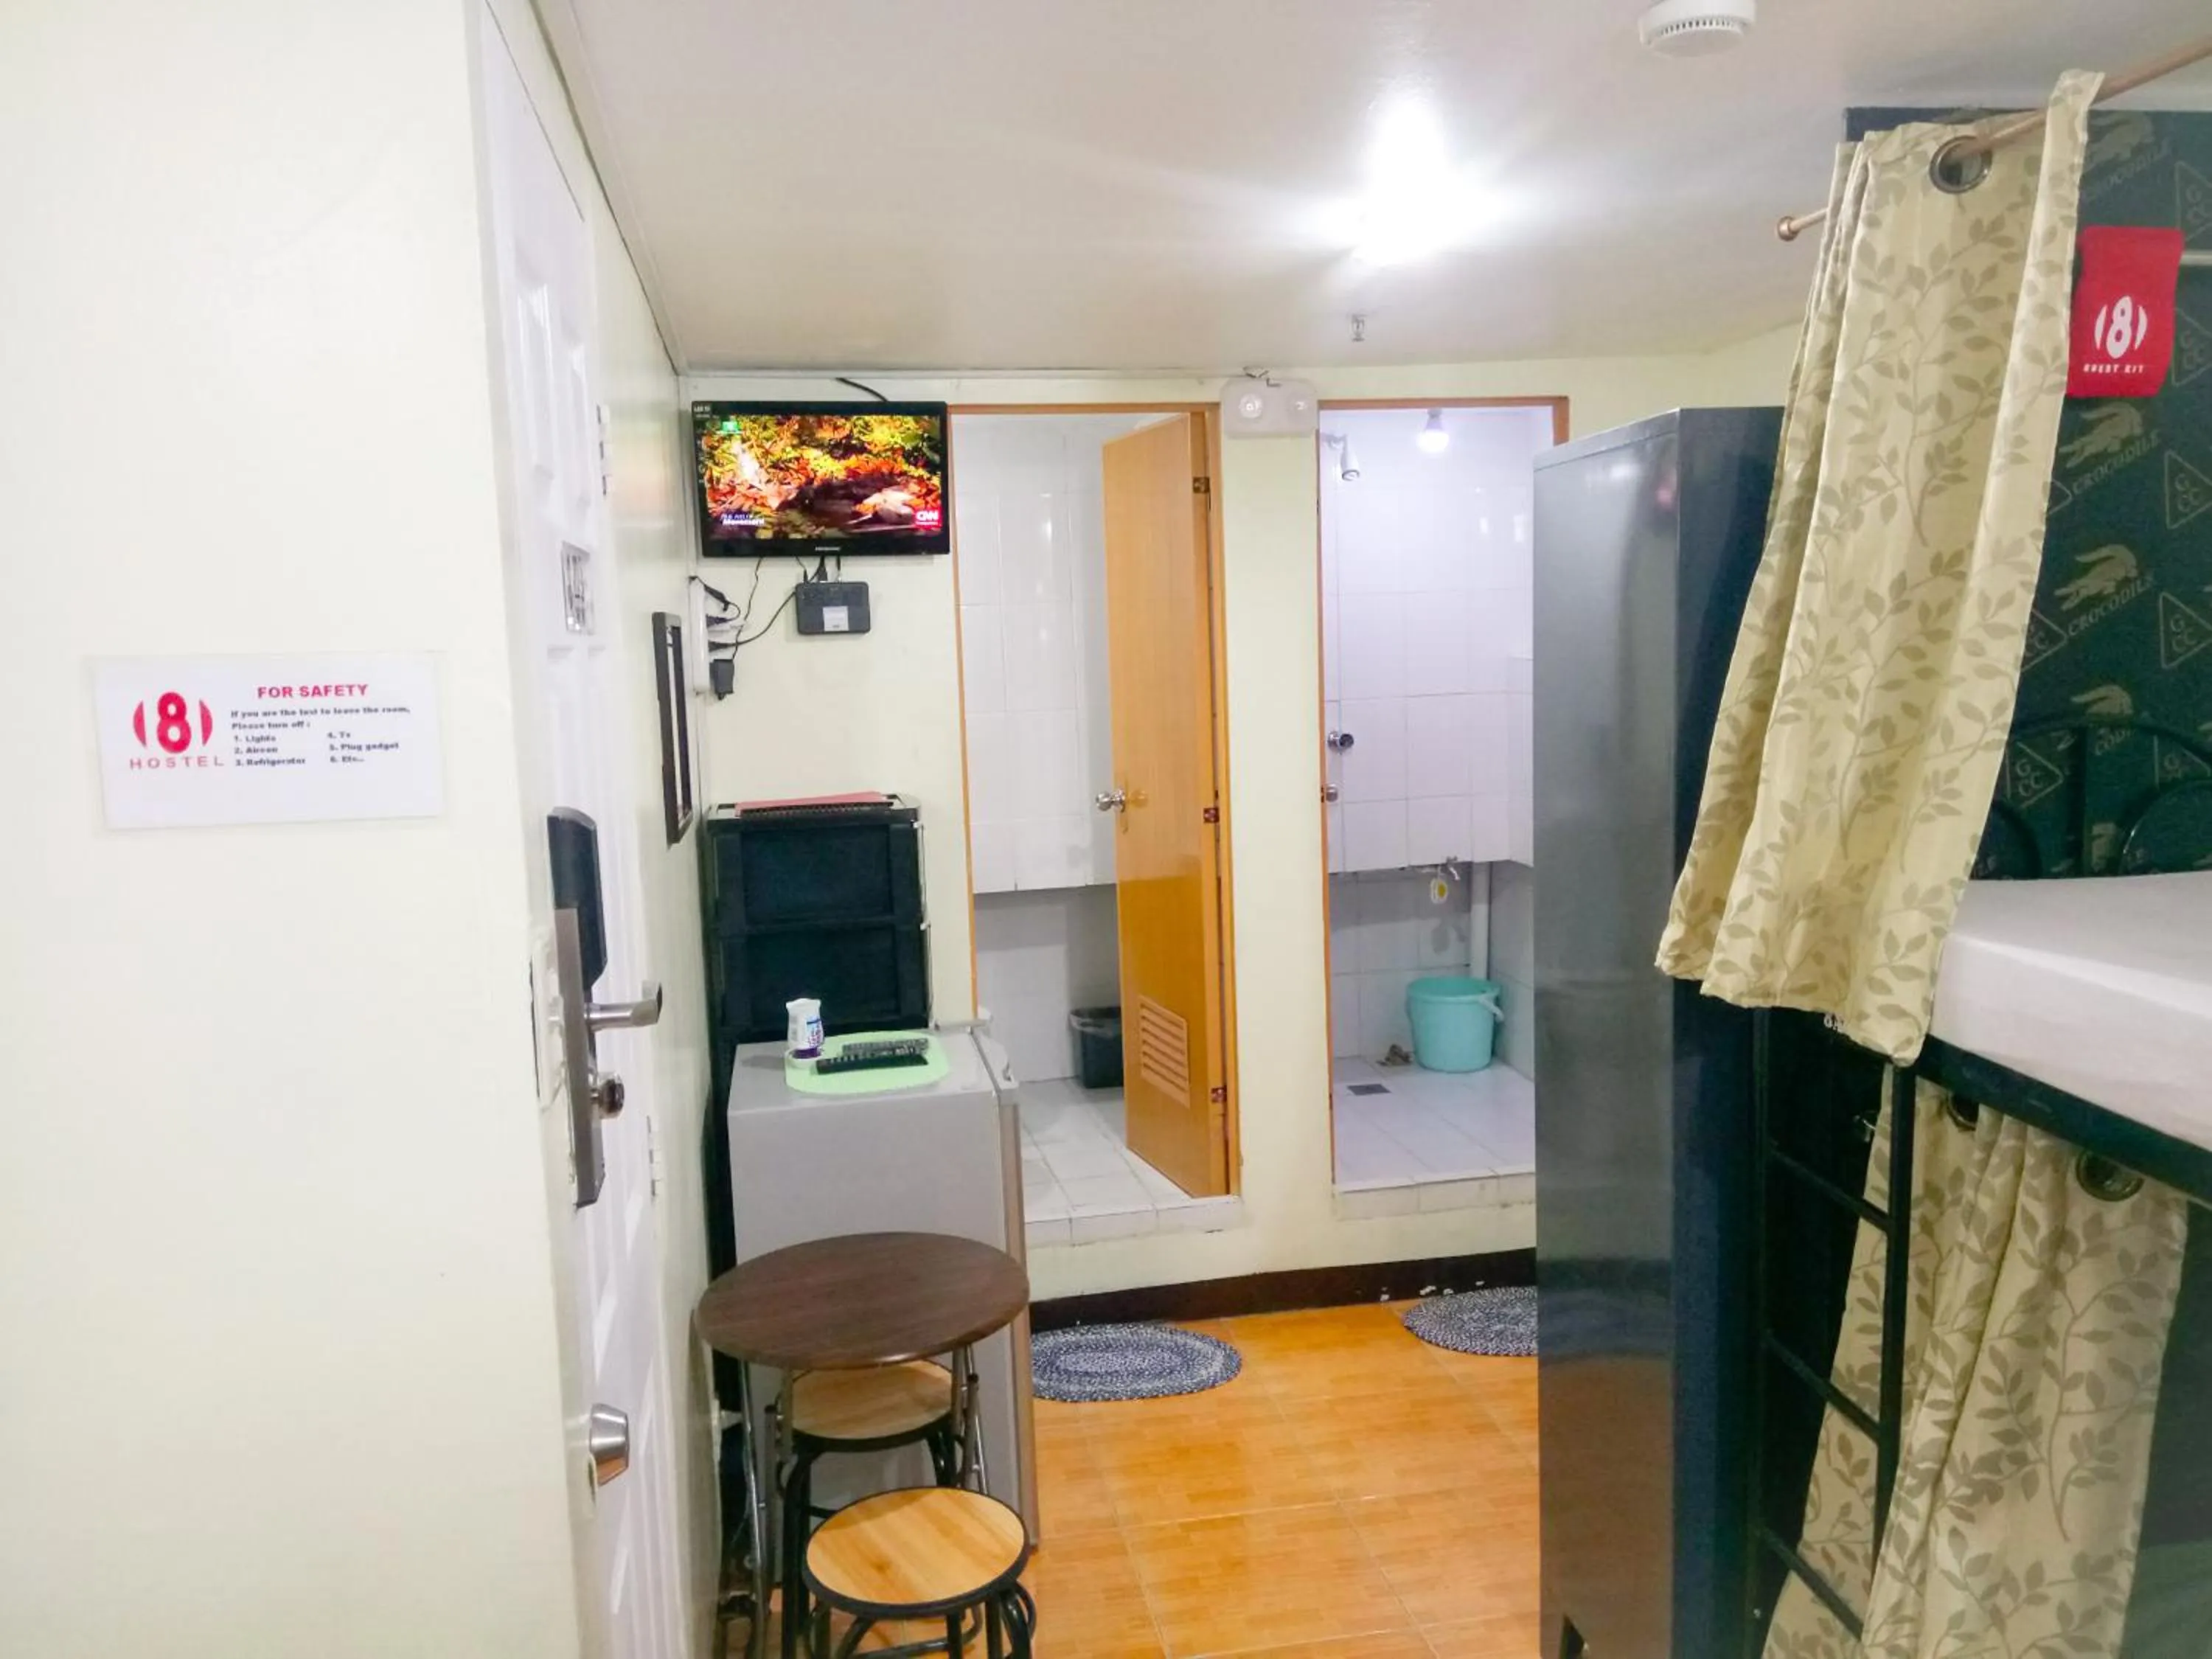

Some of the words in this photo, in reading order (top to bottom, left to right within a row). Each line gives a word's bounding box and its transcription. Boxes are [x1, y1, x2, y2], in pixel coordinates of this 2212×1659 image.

[916, 511, 938, 521] CNN
[2068, 571, 2154, 636] CROCODILE
[257, 686, 293, 698] FOR
[299, 684, 368, 698] SAFETY
[241, 711, 259, 719] you
[246, 735, 276, 743] Lights
[341, 743, 363, 751] Plug
[366, 742, 399, 751] gadget
[130, 755, 224, 770] HOSTEL
[246, 757, 306, 767] Refrigerator
